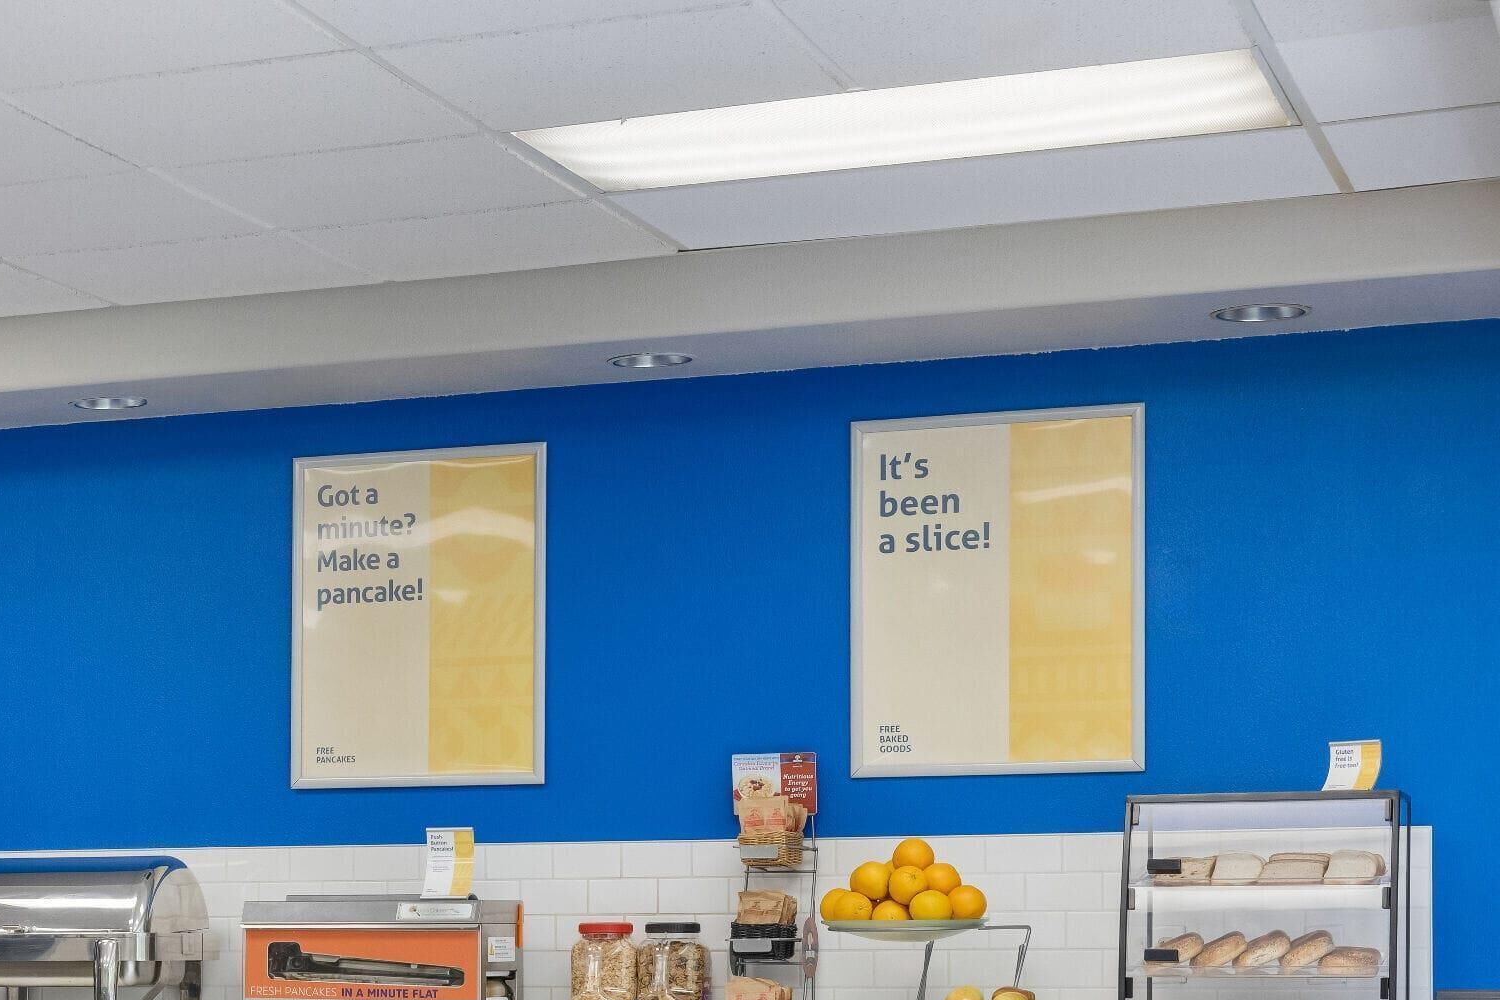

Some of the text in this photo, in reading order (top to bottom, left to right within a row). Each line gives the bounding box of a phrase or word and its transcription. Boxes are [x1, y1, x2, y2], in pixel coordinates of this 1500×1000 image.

[880, 453, 929, 481] It’s
[317, 485, 378, 507] Got a
[880, 490, 960, 517] been
[317, 513, 416, 540] minute?
[879, 522, 990, 554] a slice!
[317, 548, 399, 572] Make a
[317, 578, 423, 611] pancake!
[879, 726, 901, 734] FREE
[879, 735, 909, 743] BAKED
[316, 747, 335, 755] FREE
[879, 744, 912, 753] GOODS
[250, 986, 439, 999] FRESH PANCAKES IN A MINUTE FLAT
